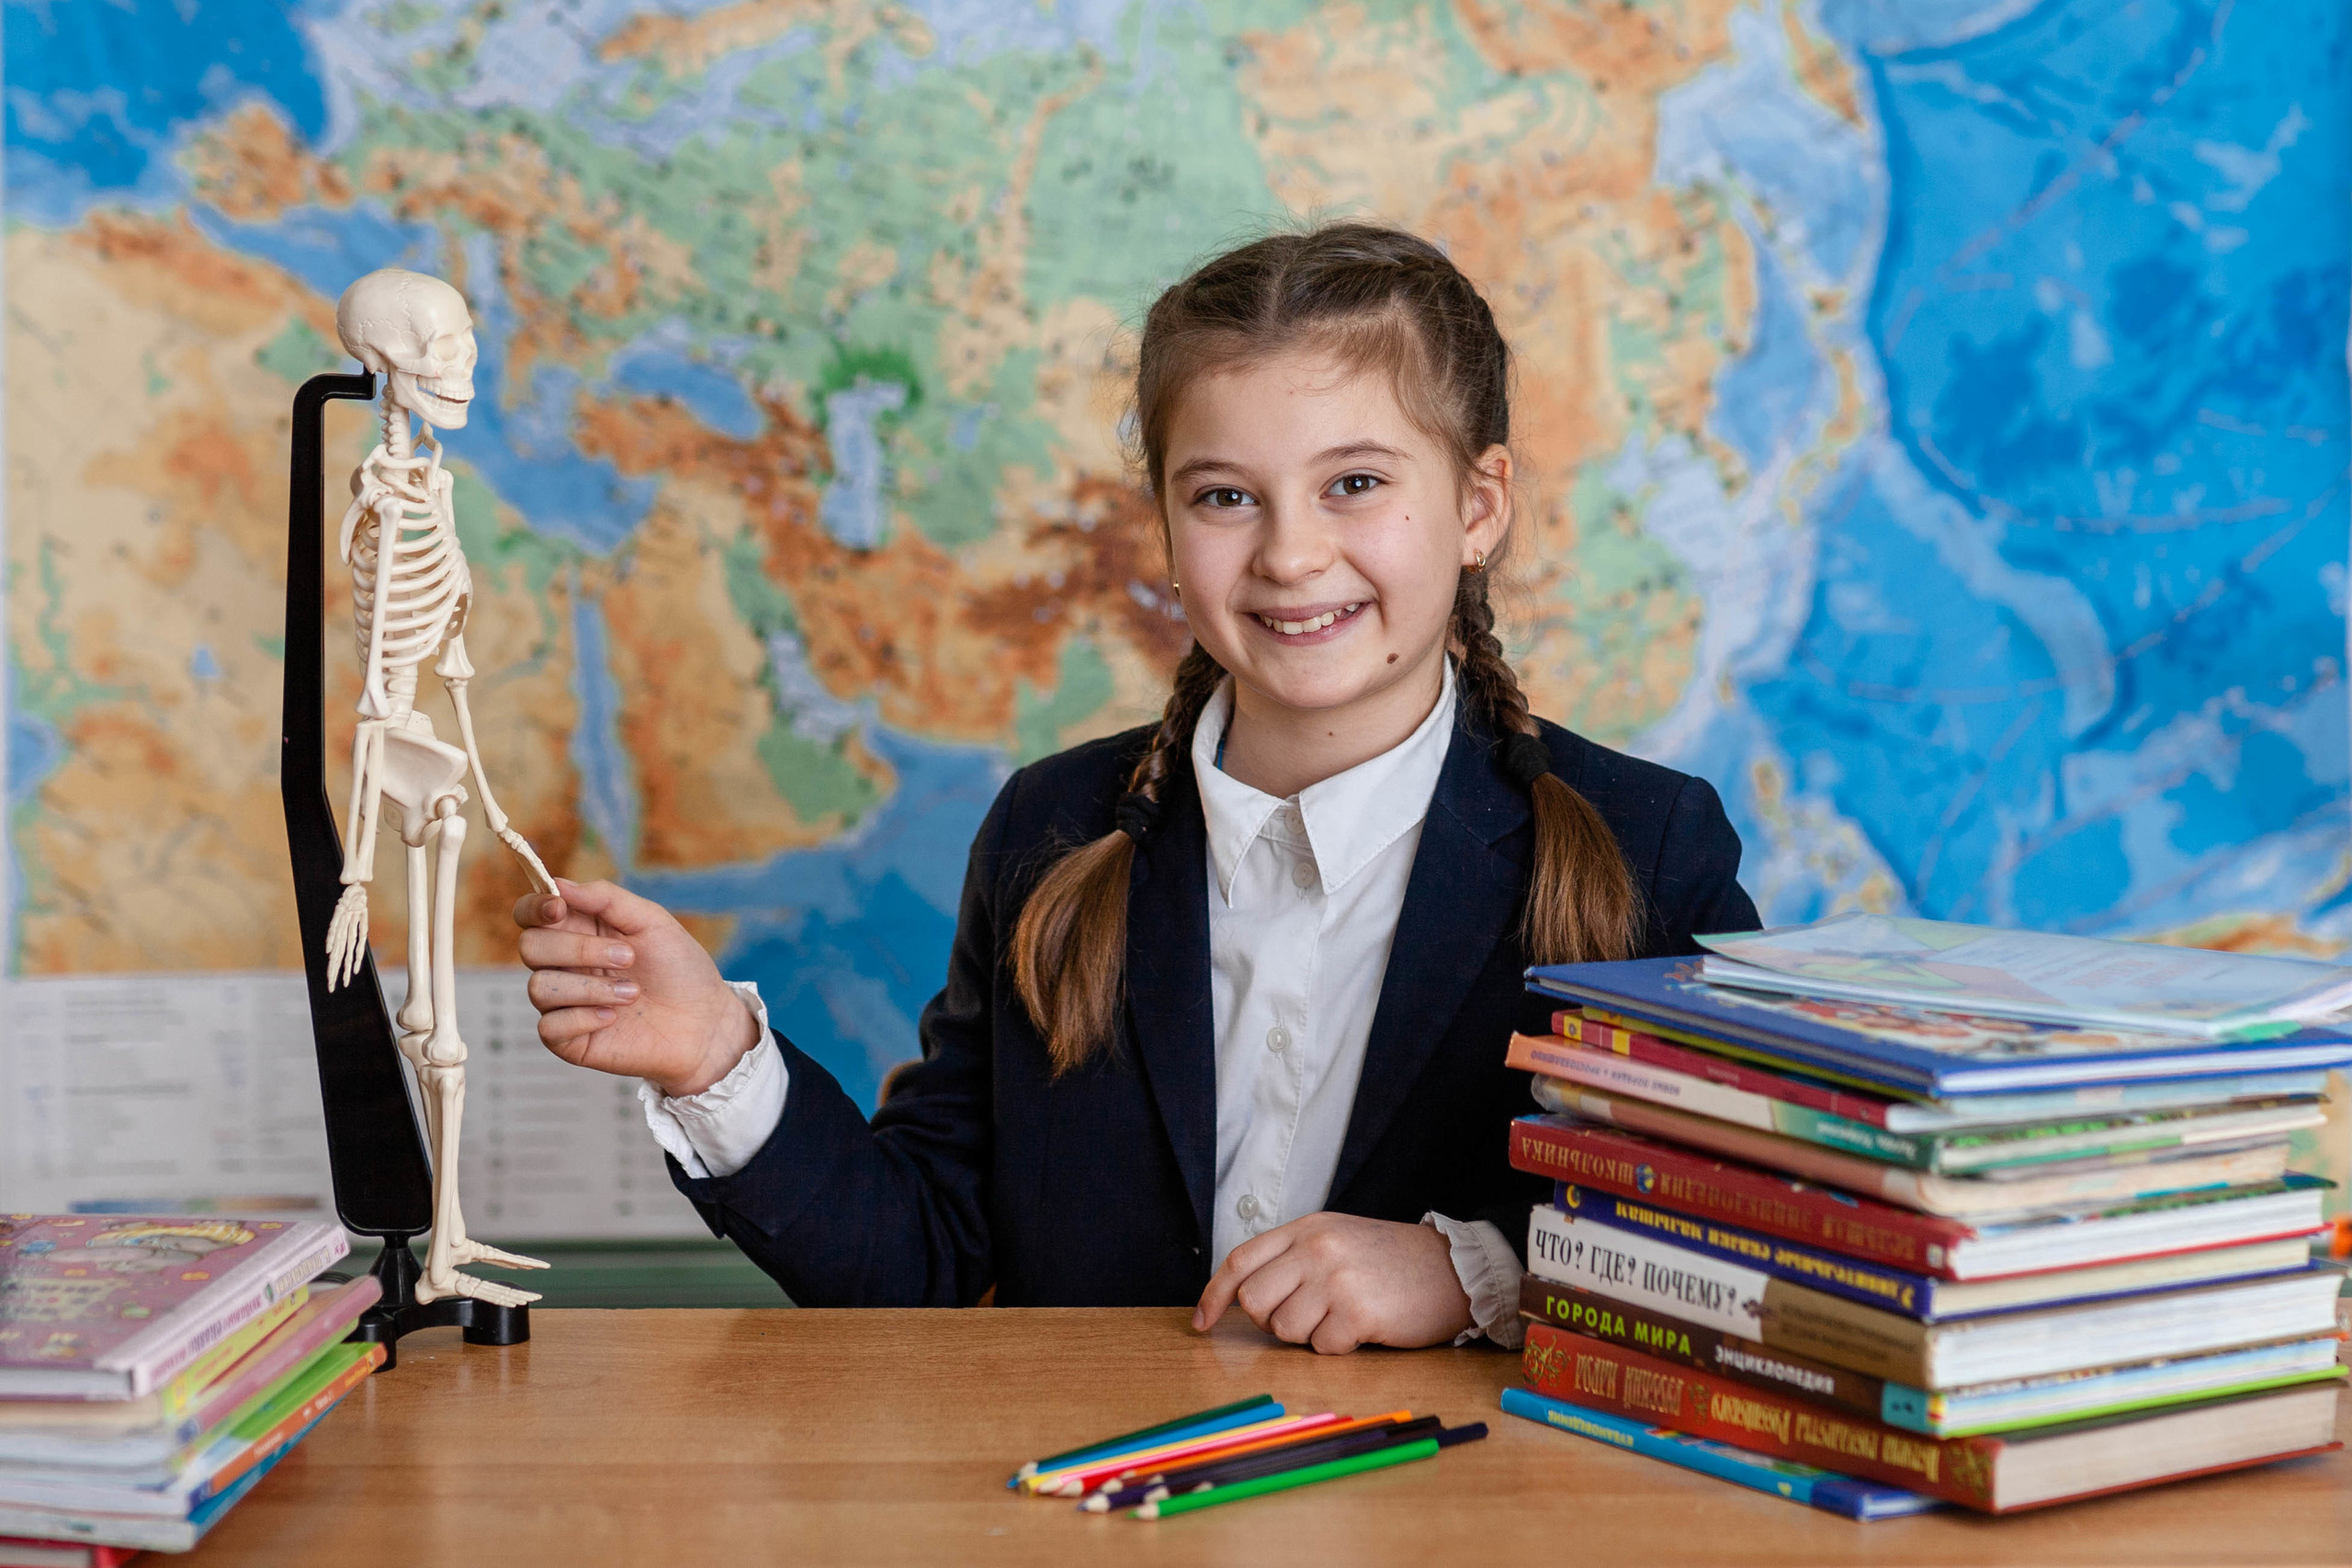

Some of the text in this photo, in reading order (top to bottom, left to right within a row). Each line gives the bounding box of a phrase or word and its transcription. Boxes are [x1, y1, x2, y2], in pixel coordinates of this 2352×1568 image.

[1521, 1137, 1634, 1185] ШКОЛЬНИКА
[1616, 1201, 1703, 1242] малышам
[1709, 1224, 1772, 1261] сказки
[1535, 1228, 1737, 1316] ЧТО? ГДЕ? ПОЧЕМУ?
[1545, 1296, 1835, 1394] ГОРОДА МИРА ЭНЦИКЛОПЕДИЯ
